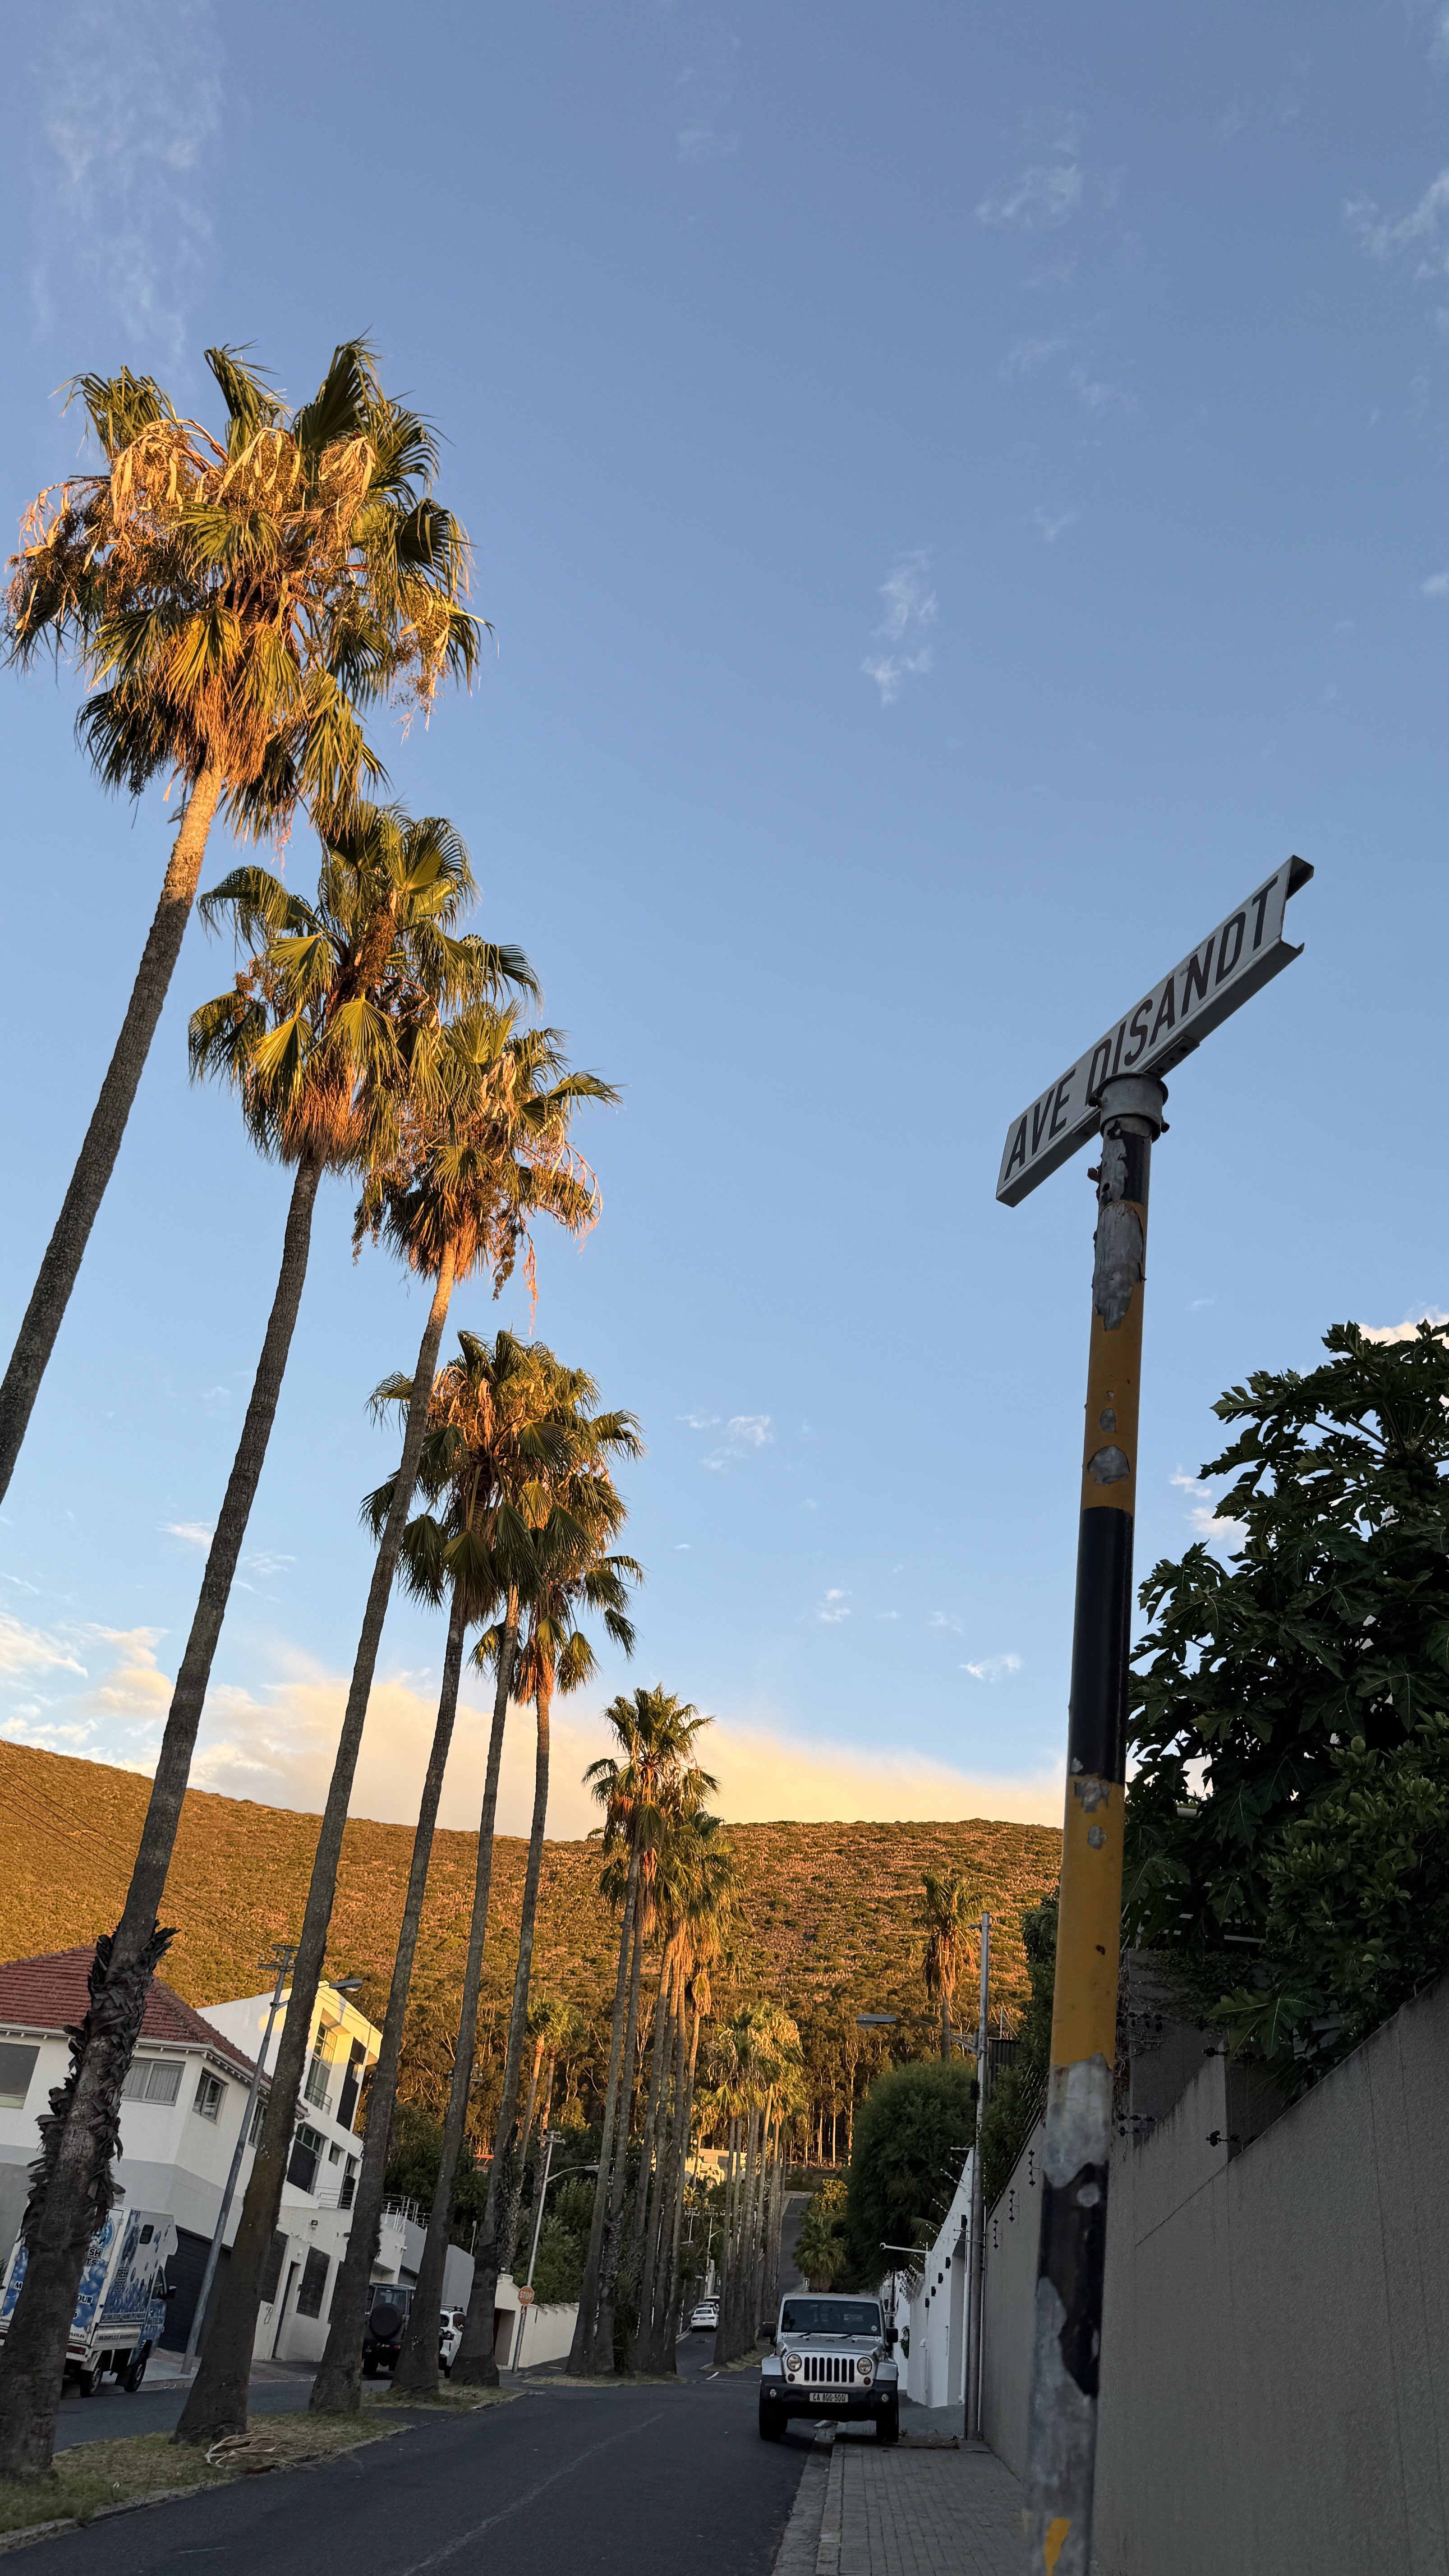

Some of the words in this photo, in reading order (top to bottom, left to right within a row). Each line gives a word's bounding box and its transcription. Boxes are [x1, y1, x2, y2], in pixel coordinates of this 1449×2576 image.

[1004, 1068, 1076, 1182] AVE
[1085, 875, 1279, 1107] DISANDT
[88, 2248, 102, 2258] SH
[519, 2291, 533, 2300] STOP
